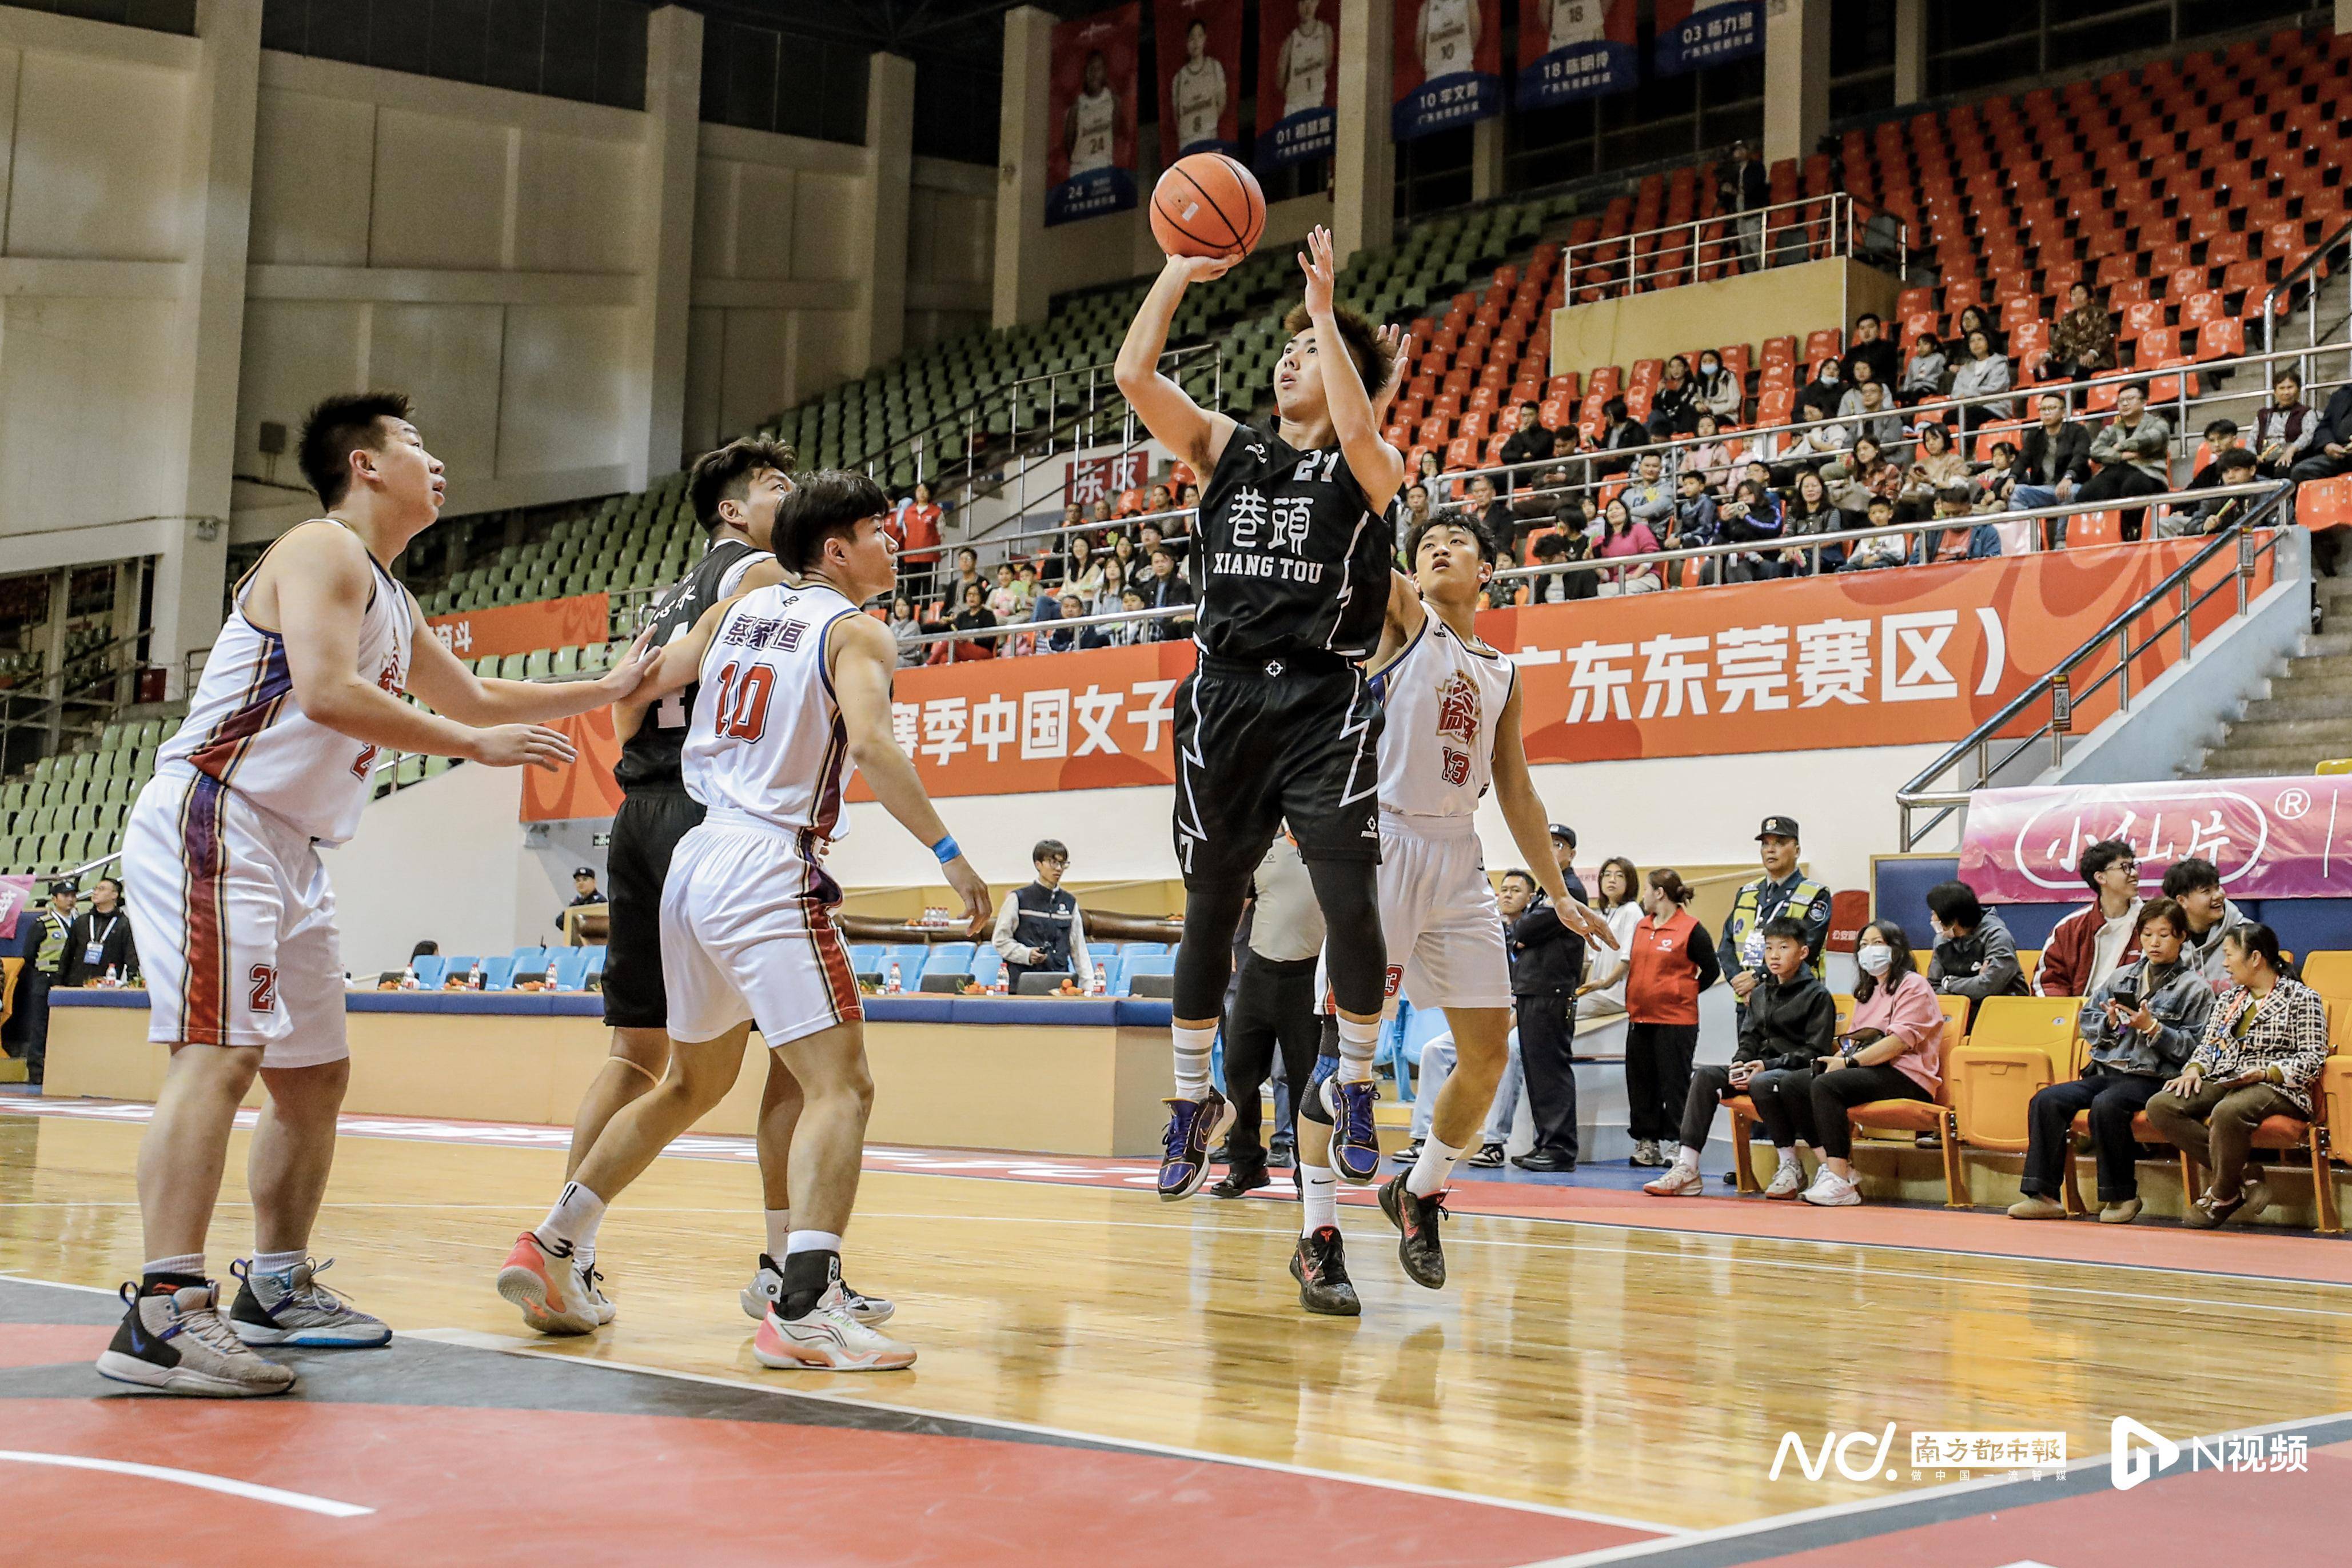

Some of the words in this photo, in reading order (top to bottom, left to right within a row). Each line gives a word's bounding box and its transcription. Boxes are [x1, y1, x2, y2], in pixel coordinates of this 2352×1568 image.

[1683, 25, 1701, 44] 03
[1544, 62, 1561, 79] 18
[1420, 93, 1437, 109] 10
[1276, 128, 1290, 145] 01
[1293, 449, 1340, 482] 21
[1228, 485, 1314, 556] 巷頭
[1213, 553, 1274, 577] XIANG
[1279, 558, 1324, 584] TOU
[715, 660, 778, 744] 10
[1442, 746, 1470, 787] 13
